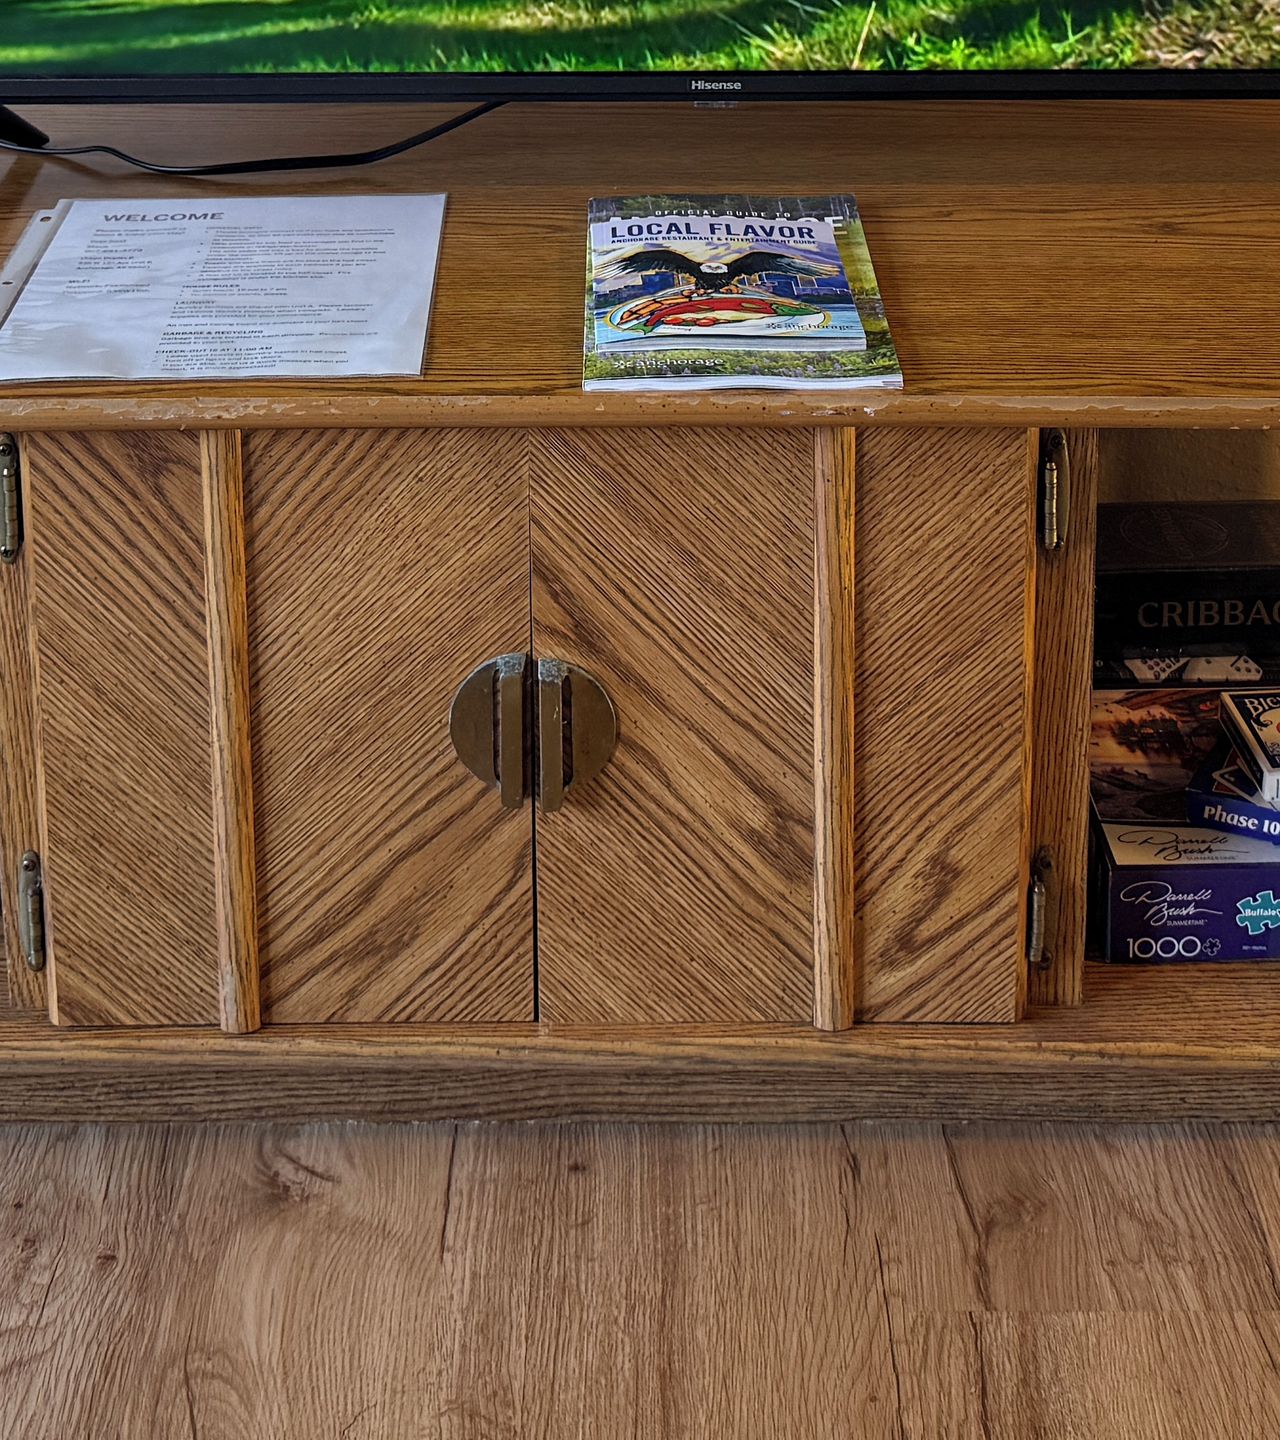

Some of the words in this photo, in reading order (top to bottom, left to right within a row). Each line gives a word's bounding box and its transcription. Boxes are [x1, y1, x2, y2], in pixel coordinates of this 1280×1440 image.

[691, 80, 742, 90] Hisense
[103, 212, 225, 222] WELCOME
[610, 222, 699, 239] LOCAL
[709, 223, 816, 240] FLAVOR
[1203, 805, 1259, 830] Phase
[1263, 819, 1280, 836] 10
[1120, 881, 1212, 905] Darrell
[1144, 902, 1223, 926] Bush
[1245, 908, 1277, 916] Buffalo
[1126, 936, 1201, 958] 1000
